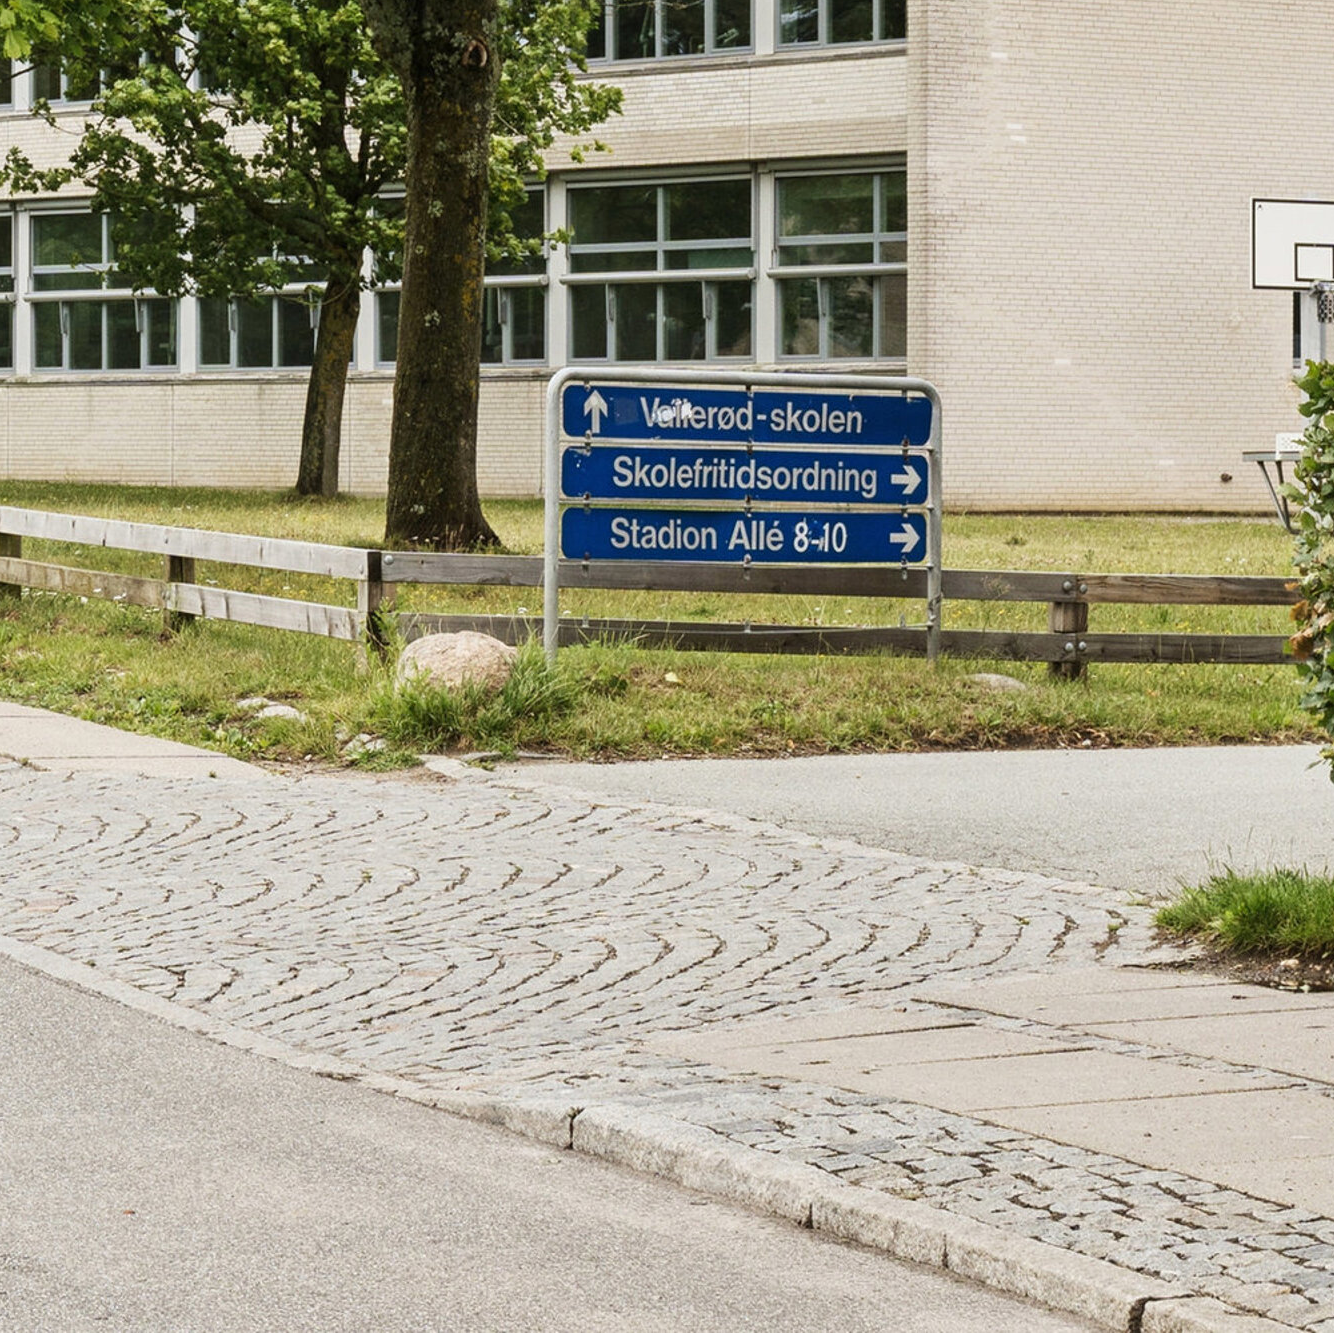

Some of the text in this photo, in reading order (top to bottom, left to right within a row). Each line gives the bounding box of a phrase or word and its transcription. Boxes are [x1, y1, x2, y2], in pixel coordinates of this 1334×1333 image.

[612, 455, 877, 499] Skolefritidsordning
[610, 516, 848, 553] Stadion Allé 8-10
